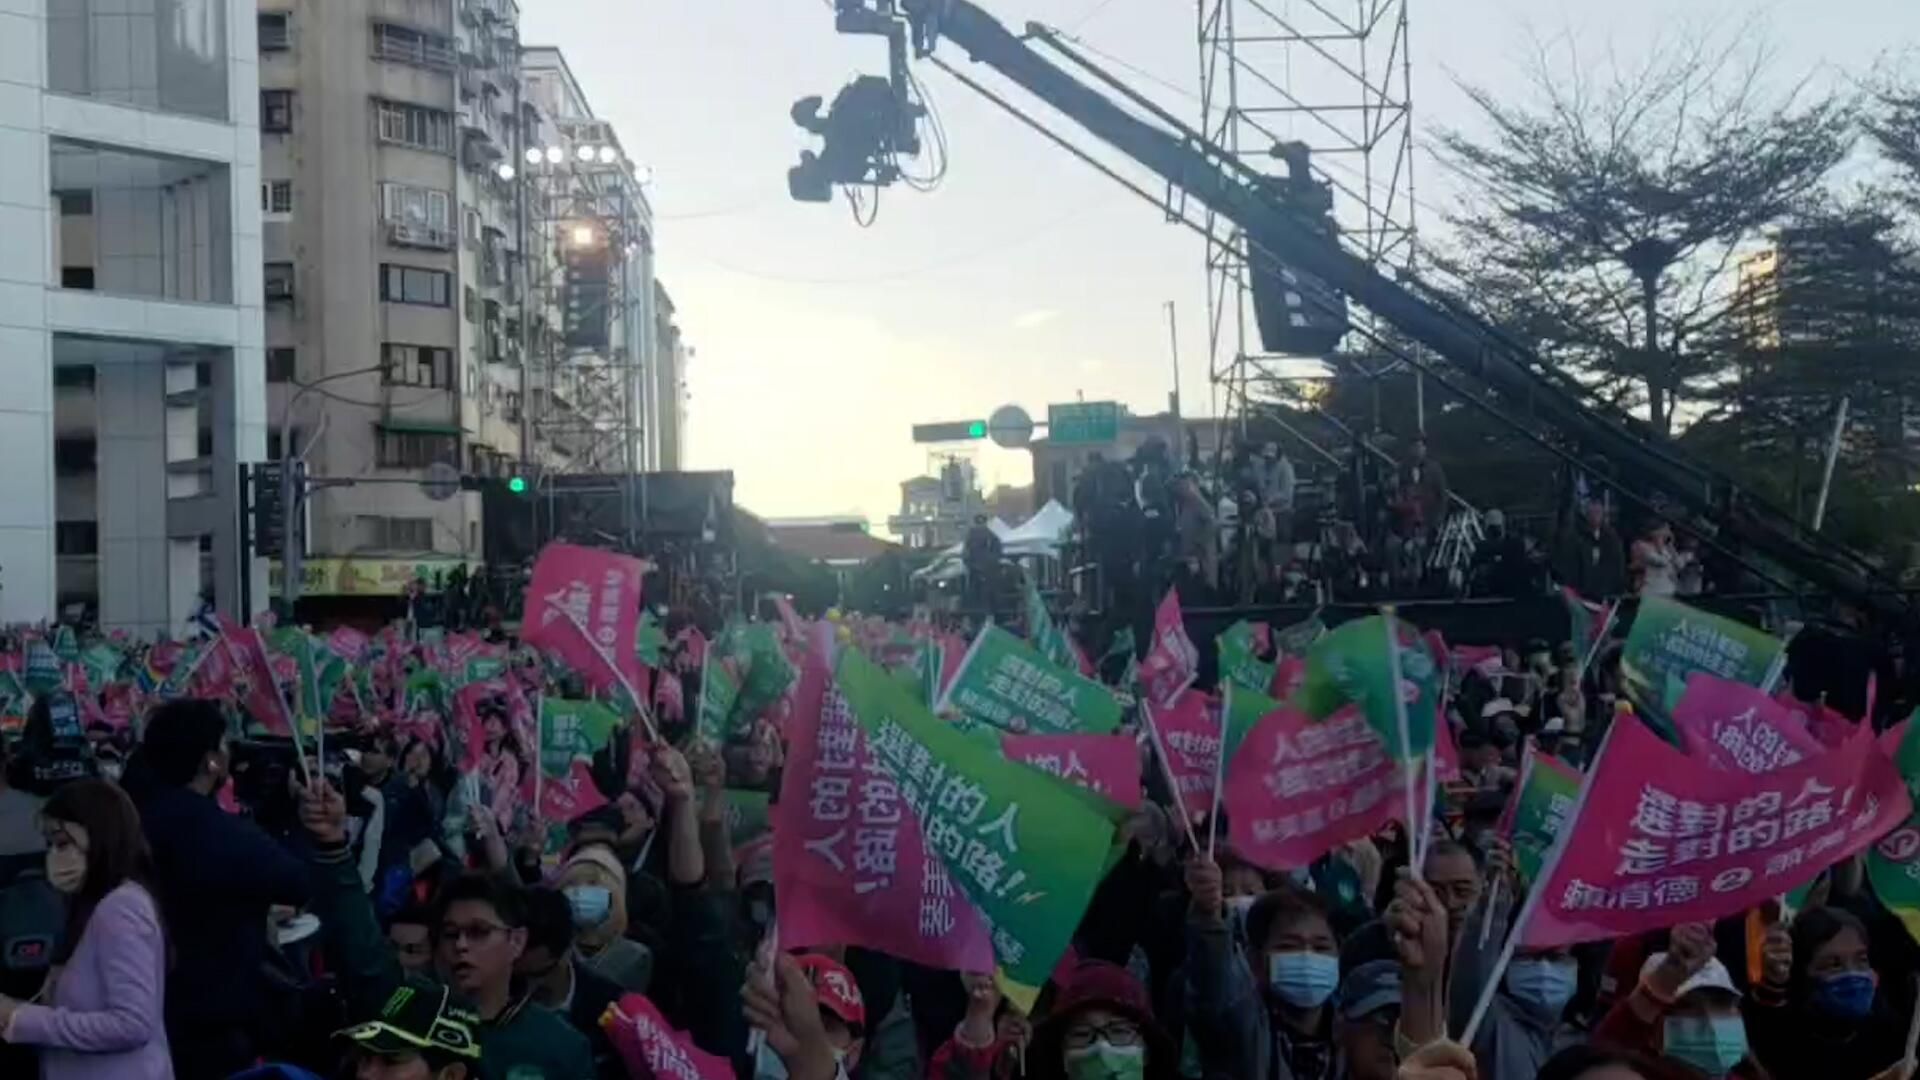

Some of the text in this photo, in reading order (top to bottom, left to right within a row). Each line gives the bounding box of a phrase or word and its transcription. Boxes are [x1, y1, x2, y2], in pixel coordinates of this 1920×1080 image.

[871, 716, 1020, 853] 選對的人
[1630, 777, 1836, 837] 選對的人
[1616, 785, 1854, 876] 走對的路!
